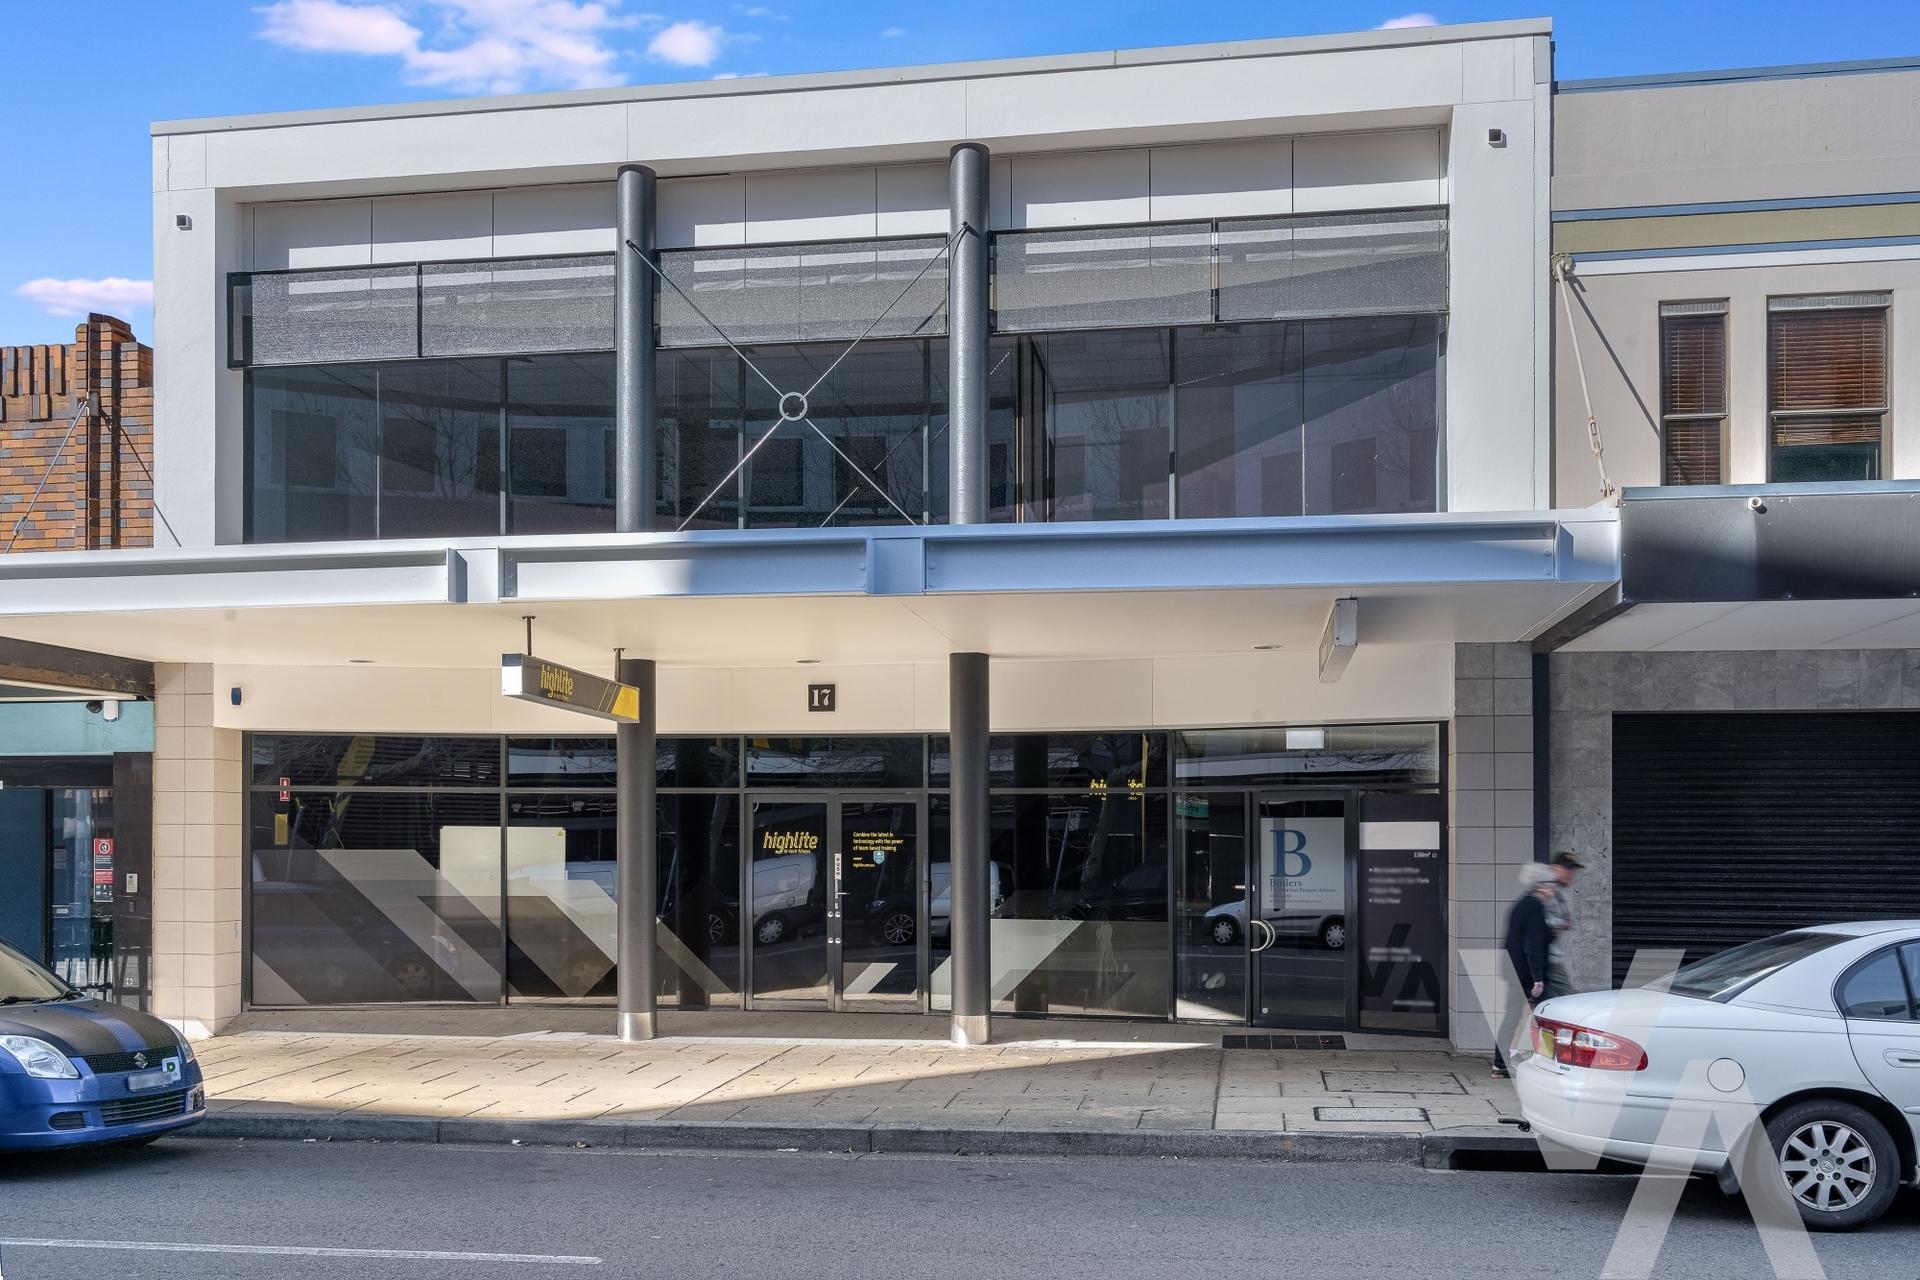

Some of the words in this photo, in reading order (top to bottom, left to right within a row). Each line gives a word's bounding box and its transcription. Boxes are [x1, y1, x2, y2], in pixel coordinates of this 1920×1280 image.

[541, 664, 573, 698] highlite
[812, 689, 831, 706] 17
[763, 832, 818, 854] highlite
[1270, 830, 1312, 877] B
